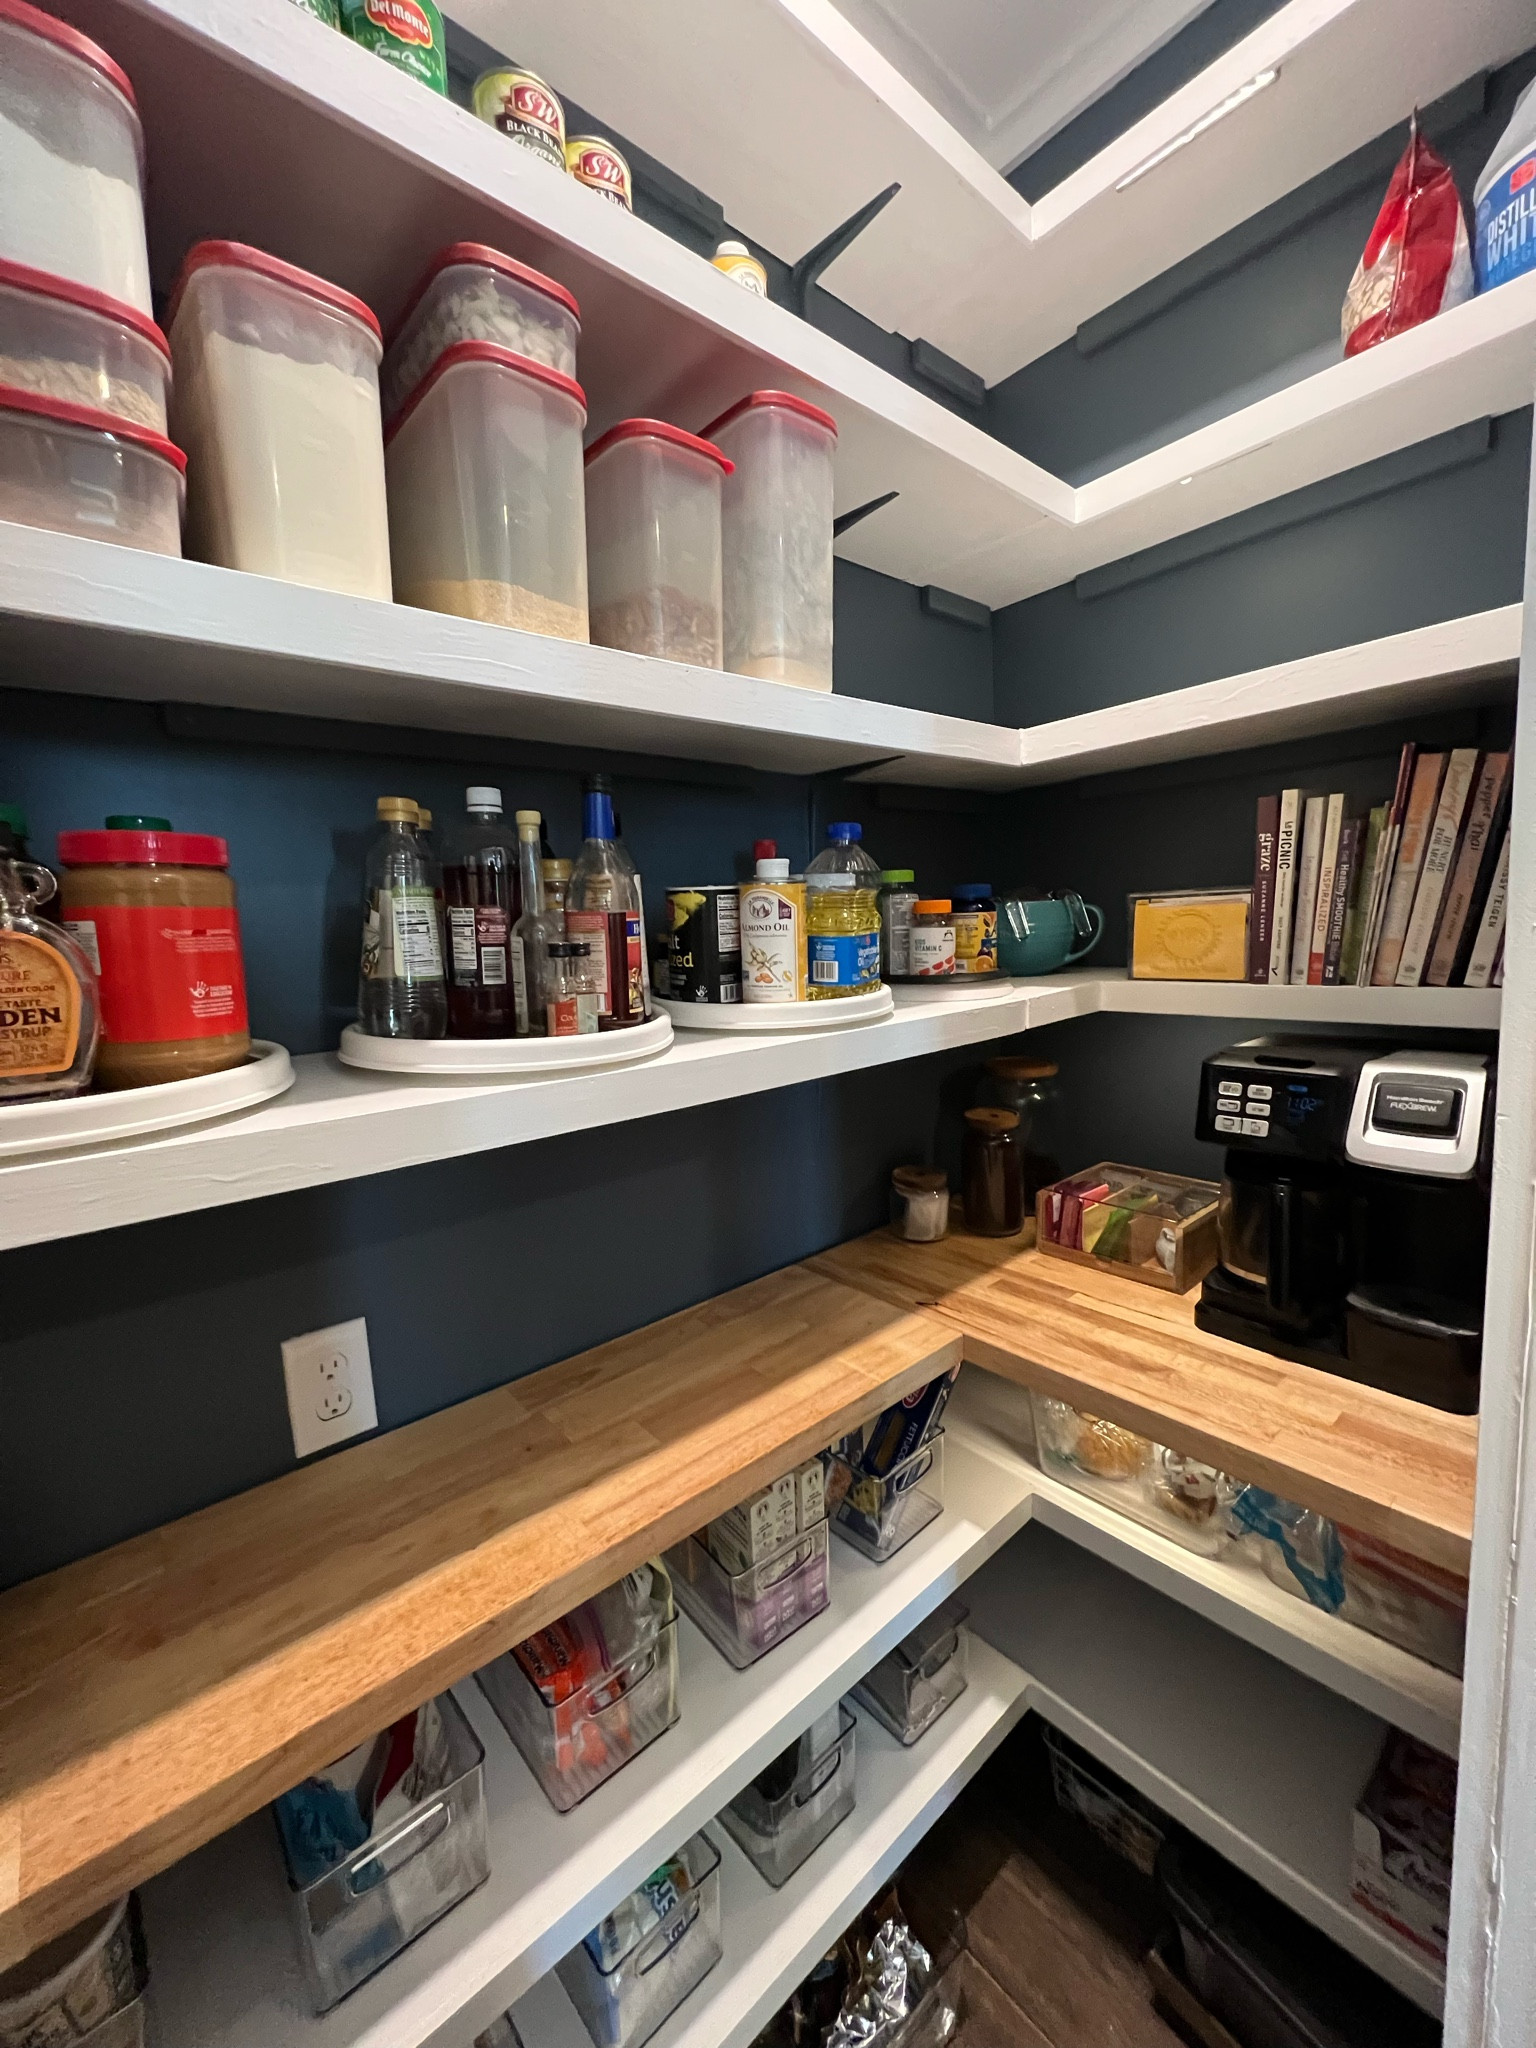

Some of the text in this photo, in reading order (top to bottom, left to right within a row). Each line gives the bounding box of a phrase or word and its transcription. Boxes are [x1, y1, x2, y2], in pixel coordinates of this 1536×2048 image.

[370, 0, 430, 38] Del Monte
[506, 119, 541, 139] BLACK
[1479, 777, 1496, 819] Pepper
[1258, 832, 1274, 872] graze
[1279, 830, 1293, 870] PICNIC
[1425, 827, 1445, 873] FOR MORE
[1317, 866, 1332, 932] INSPIRALIZED
[1335, 864, 1349, 897] Healthy
[742, 922, 789, 931] ALMOND OIL
[1331, 896, 1345, 941] SMOOTHIE
[1487, 889, 1505, 928] TEIGEN
[915, 944, 937, 952] VITAMIN
[5, 999, 41, 1008] TASTE
[1, 1026, 51, 1039] SYRUP
[897, 1421, 919, 1464] FETTUCCI
